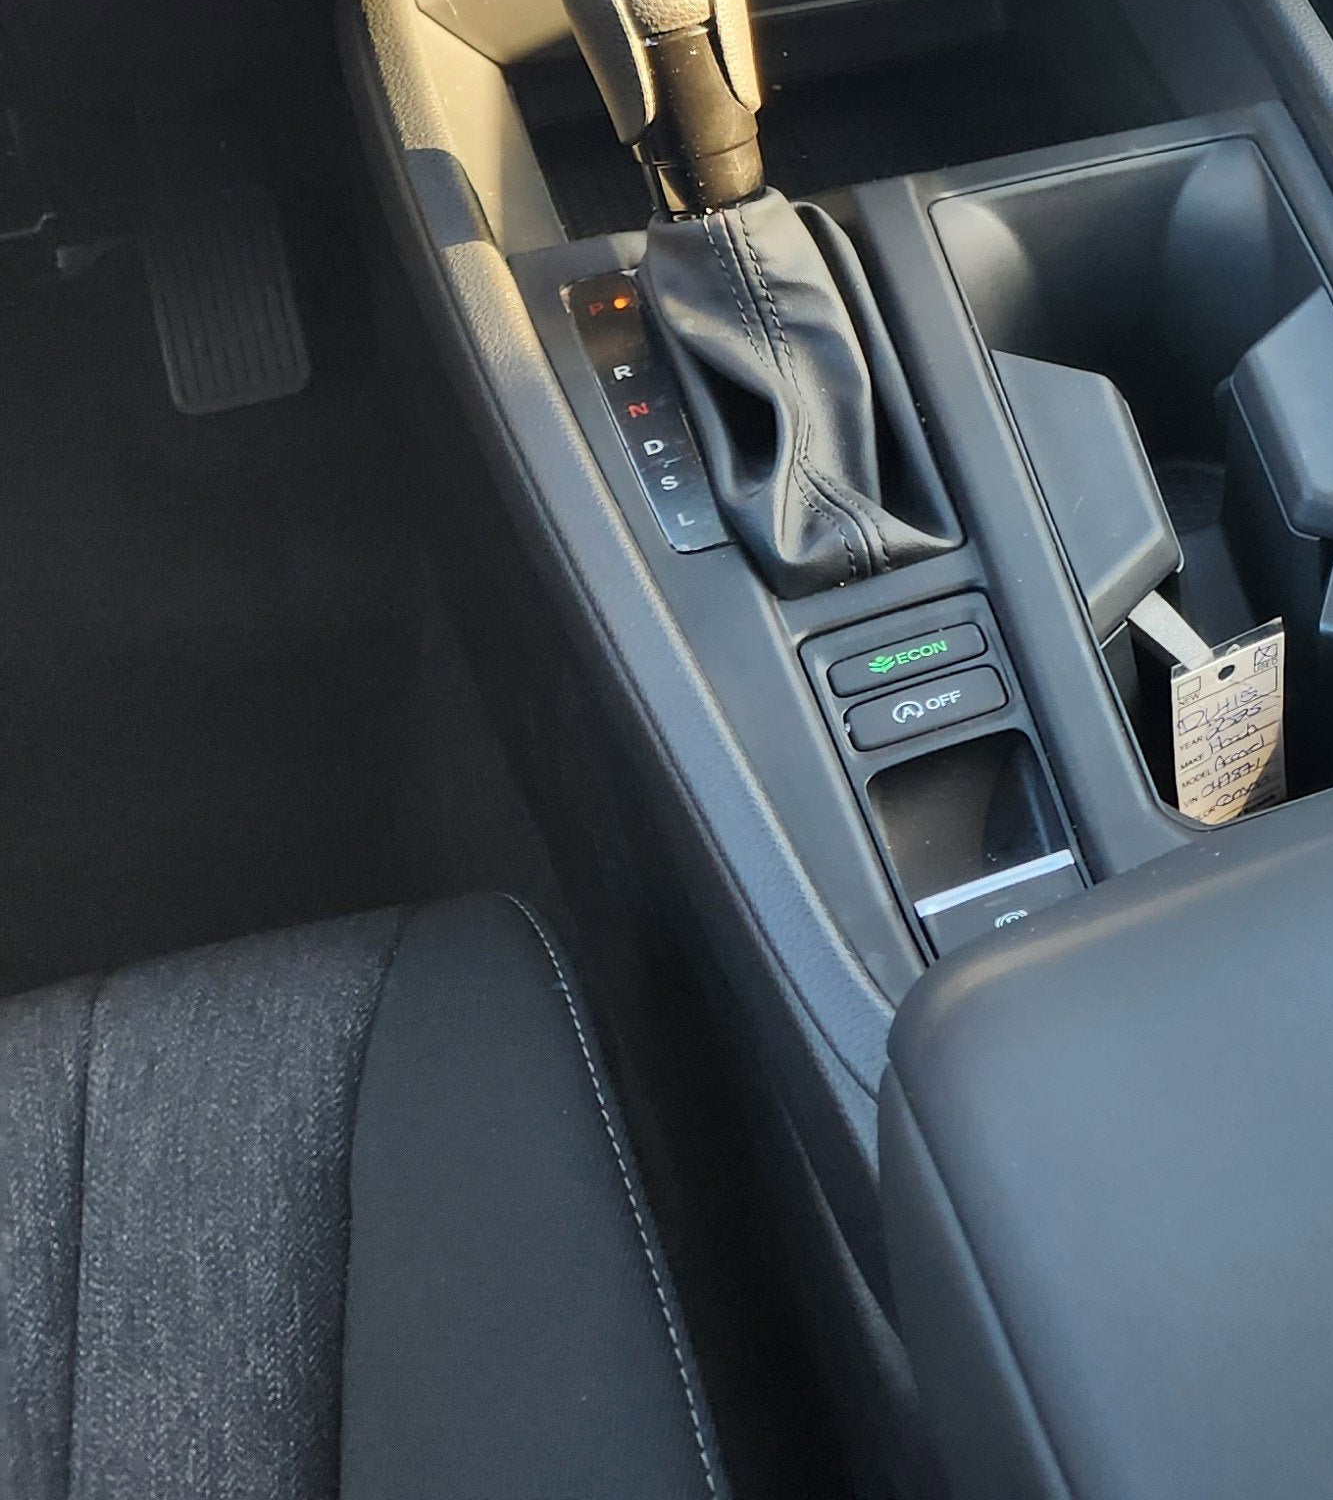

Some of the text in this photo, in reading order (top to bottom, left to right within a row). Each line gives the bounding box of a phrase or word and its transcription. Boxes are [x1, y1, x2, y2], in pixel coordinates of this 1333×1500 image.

[588, 301, 604, 316] P
[613, 364, 634, 381] R
[627, 402, 650, 419] N
[643, 439, 666, 456] D
[660, 475, 680, 492] S
[676, 512, 695, 528] L
[894, 639, 948, 667] ECON
[925, 689, 962, 712] OFF
